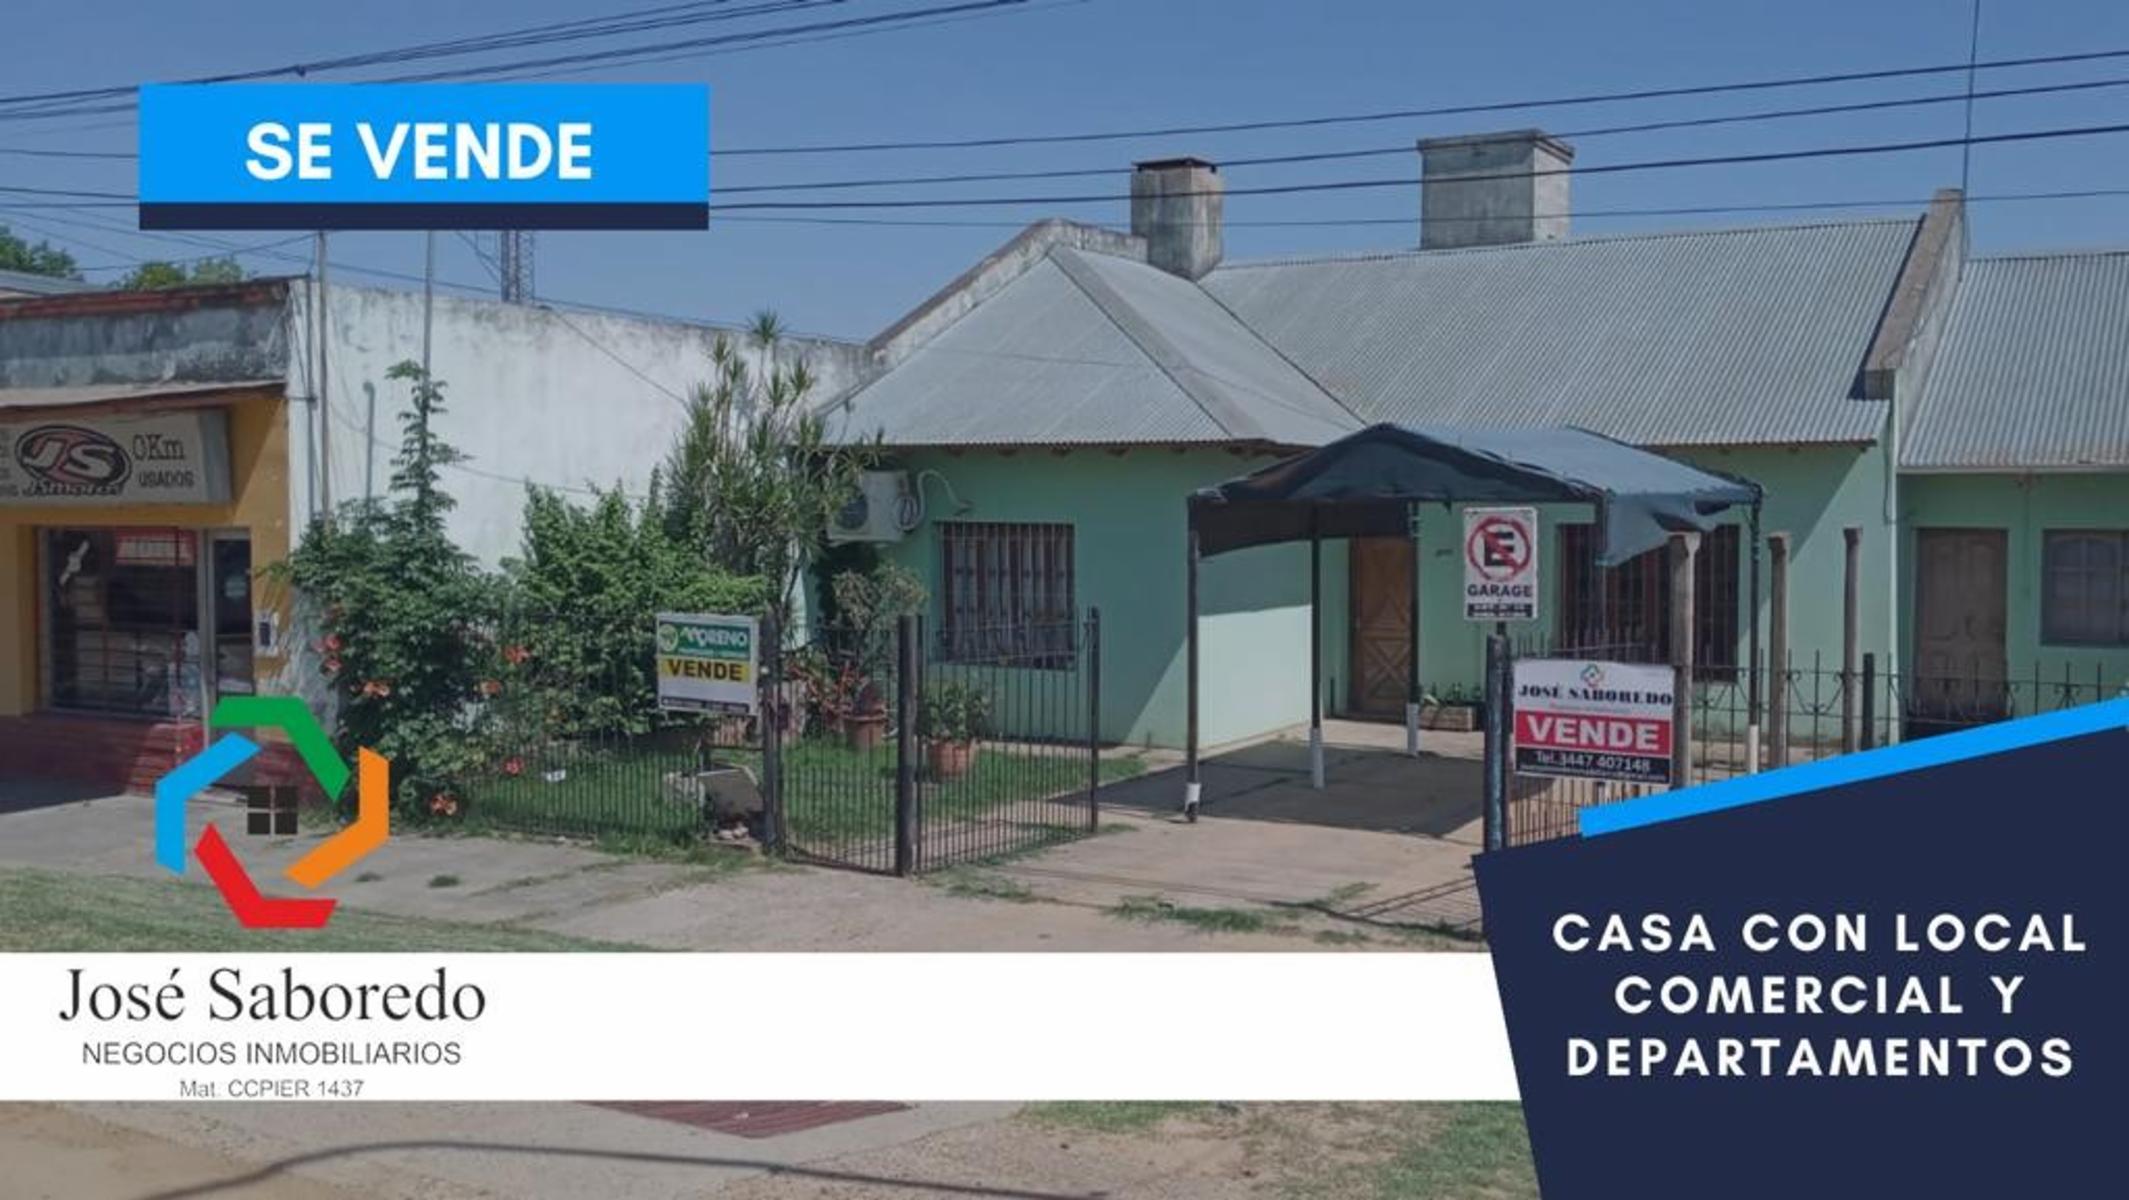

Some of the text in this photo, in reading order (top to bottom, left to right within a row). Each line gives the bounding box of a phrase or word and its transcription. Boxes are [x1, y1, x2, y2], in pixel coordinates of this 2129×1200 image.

[138, 470, 196, 489] USADOS
[1467, 584, 1533, 598] GARAGE
[680, 626, 748, 647] MORENO
[667, 659, 744, 681] VENDE
[1568, 687, 1673, 706] SABOREDO
[1527, 714, 1661, 751] VENDE
[1596, 756, 1651, 772] 407148
